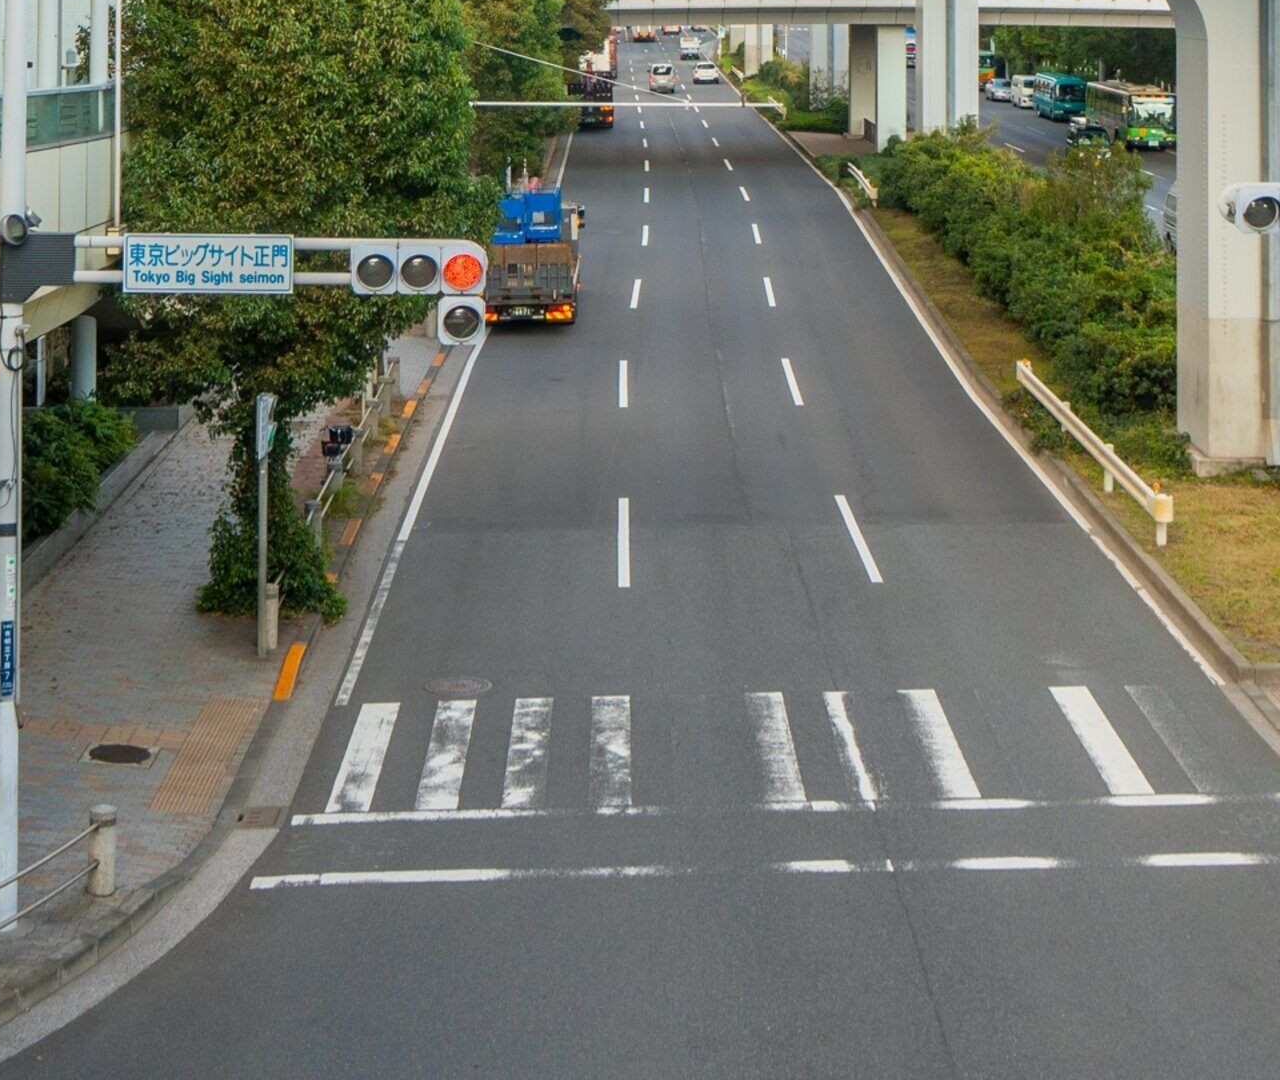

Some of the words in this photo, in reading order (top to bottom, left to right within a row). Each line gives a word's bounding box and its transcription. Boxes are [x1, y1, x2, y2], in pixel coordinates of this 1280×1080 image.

[128, 242, 288, 268] 東京ビッグサイト正門
[133, 270, 170, 285] Tokyo
[175, 270, 196, 285] Big
[201, 270, 233, 285] Sight
[239, 270, 284, 284] seimon
